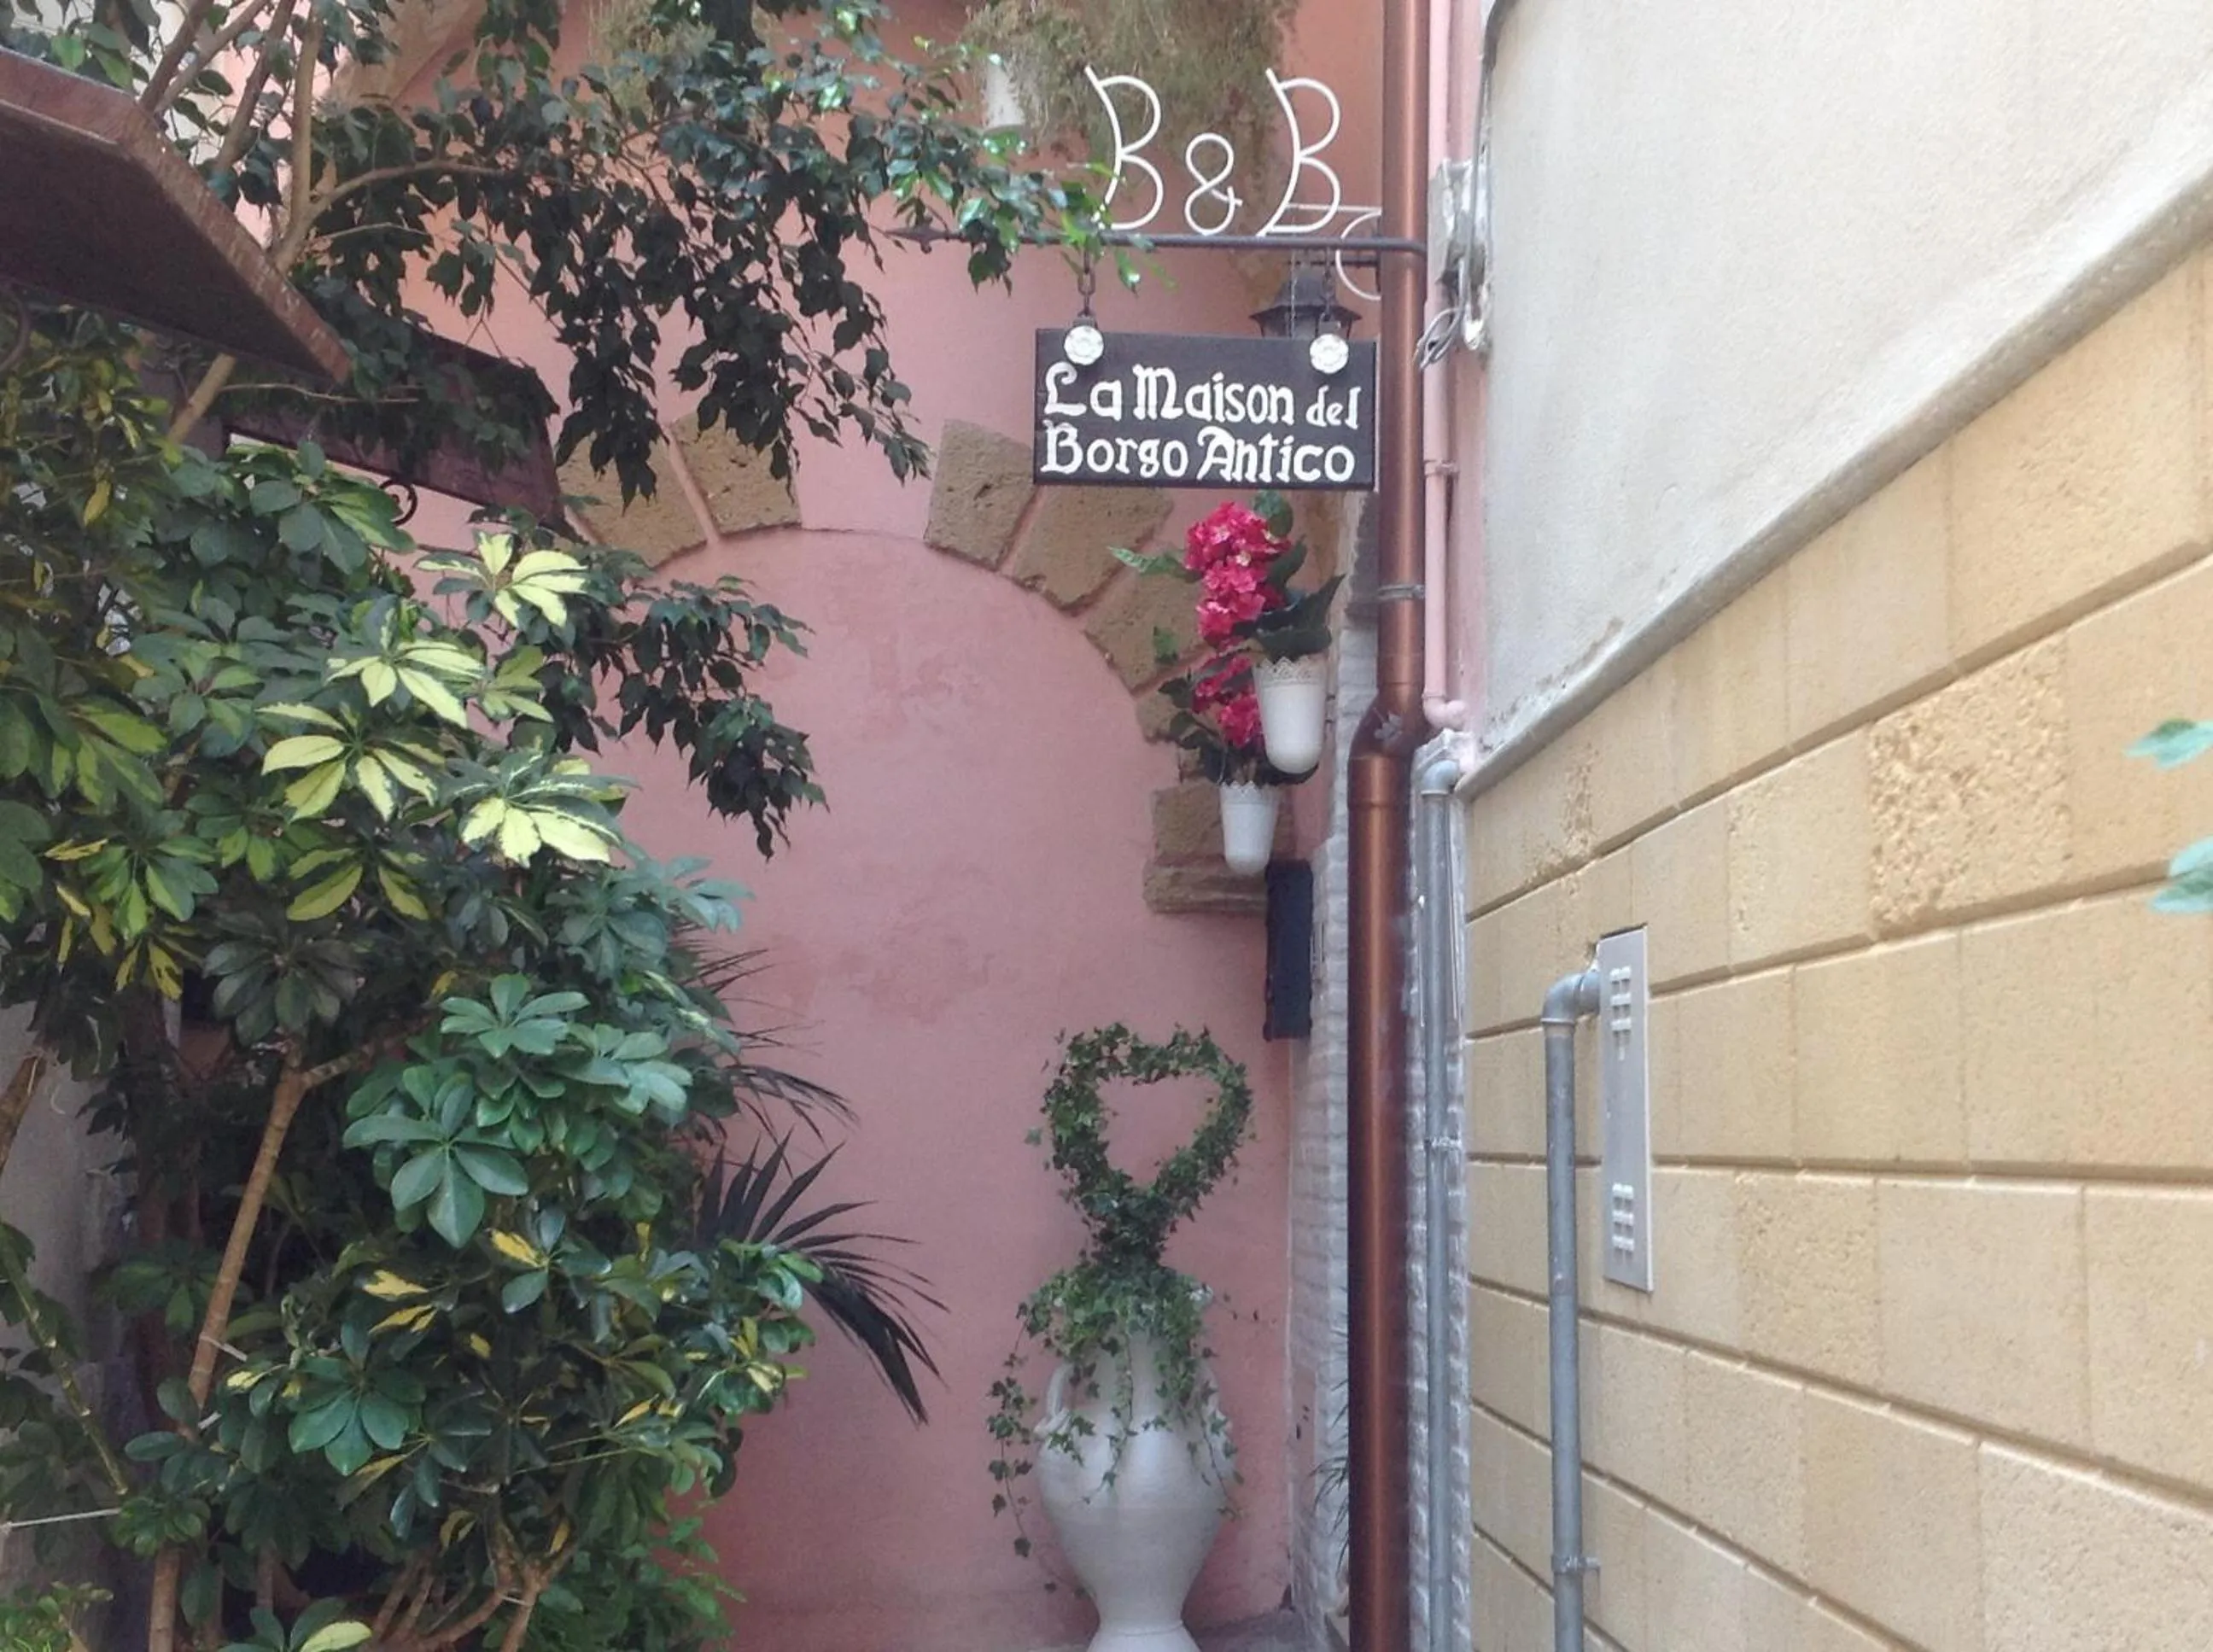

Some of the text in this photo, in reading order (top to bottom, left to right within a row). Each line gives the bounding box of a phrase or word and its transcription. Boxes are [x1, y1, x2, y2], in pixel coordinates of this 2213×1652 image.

[1042, 361, 1362, 429] La Maison del
[1040, 420, 1356, 483] Borgo Antico
